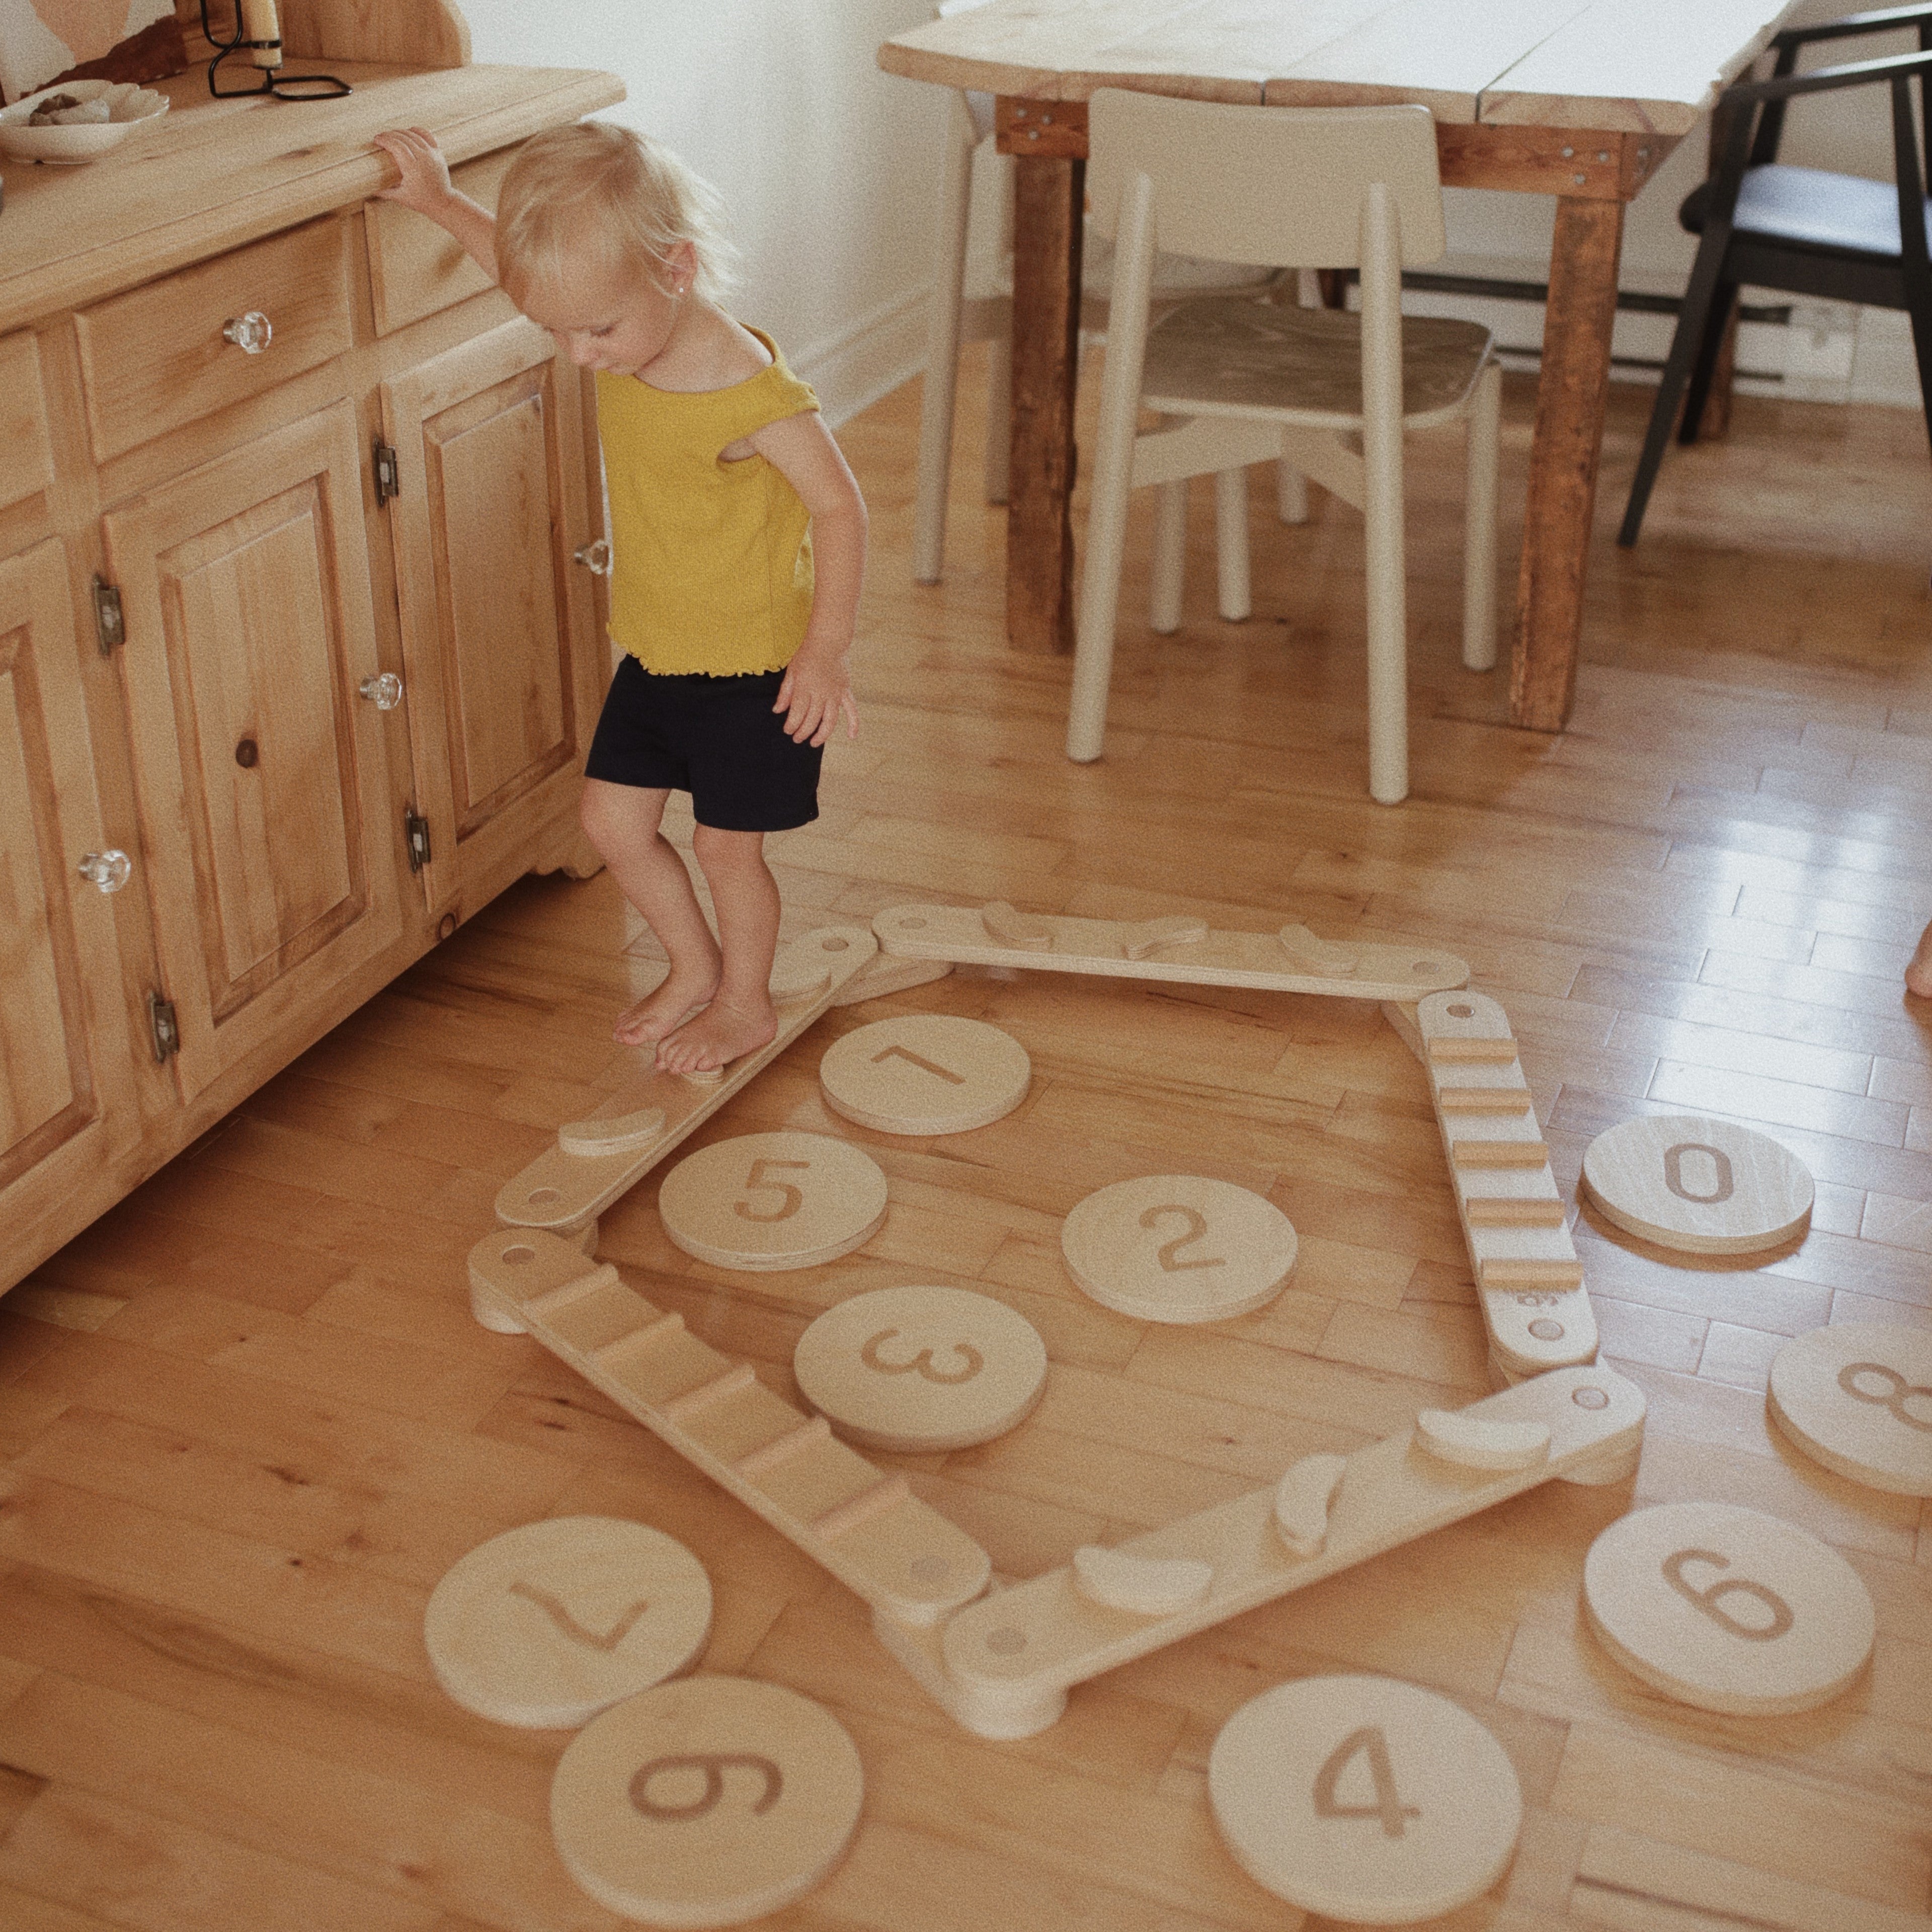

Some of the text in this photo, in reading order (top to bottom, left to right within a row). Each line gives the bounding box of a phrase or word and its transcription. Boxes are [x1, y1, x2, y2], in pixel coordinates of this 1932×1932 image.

[871, 1044, 966, 1085] 1
[734, 1159, 810, 1223] 5
[1138, 1204, 1226, 1272] 2
[860, 1328, 984, 1385] 3
[1837, 1362, 1932, 1432] 8
[509, 1582, 648, 1650] 7
[1312, 1725, 1422, 1840] 4
